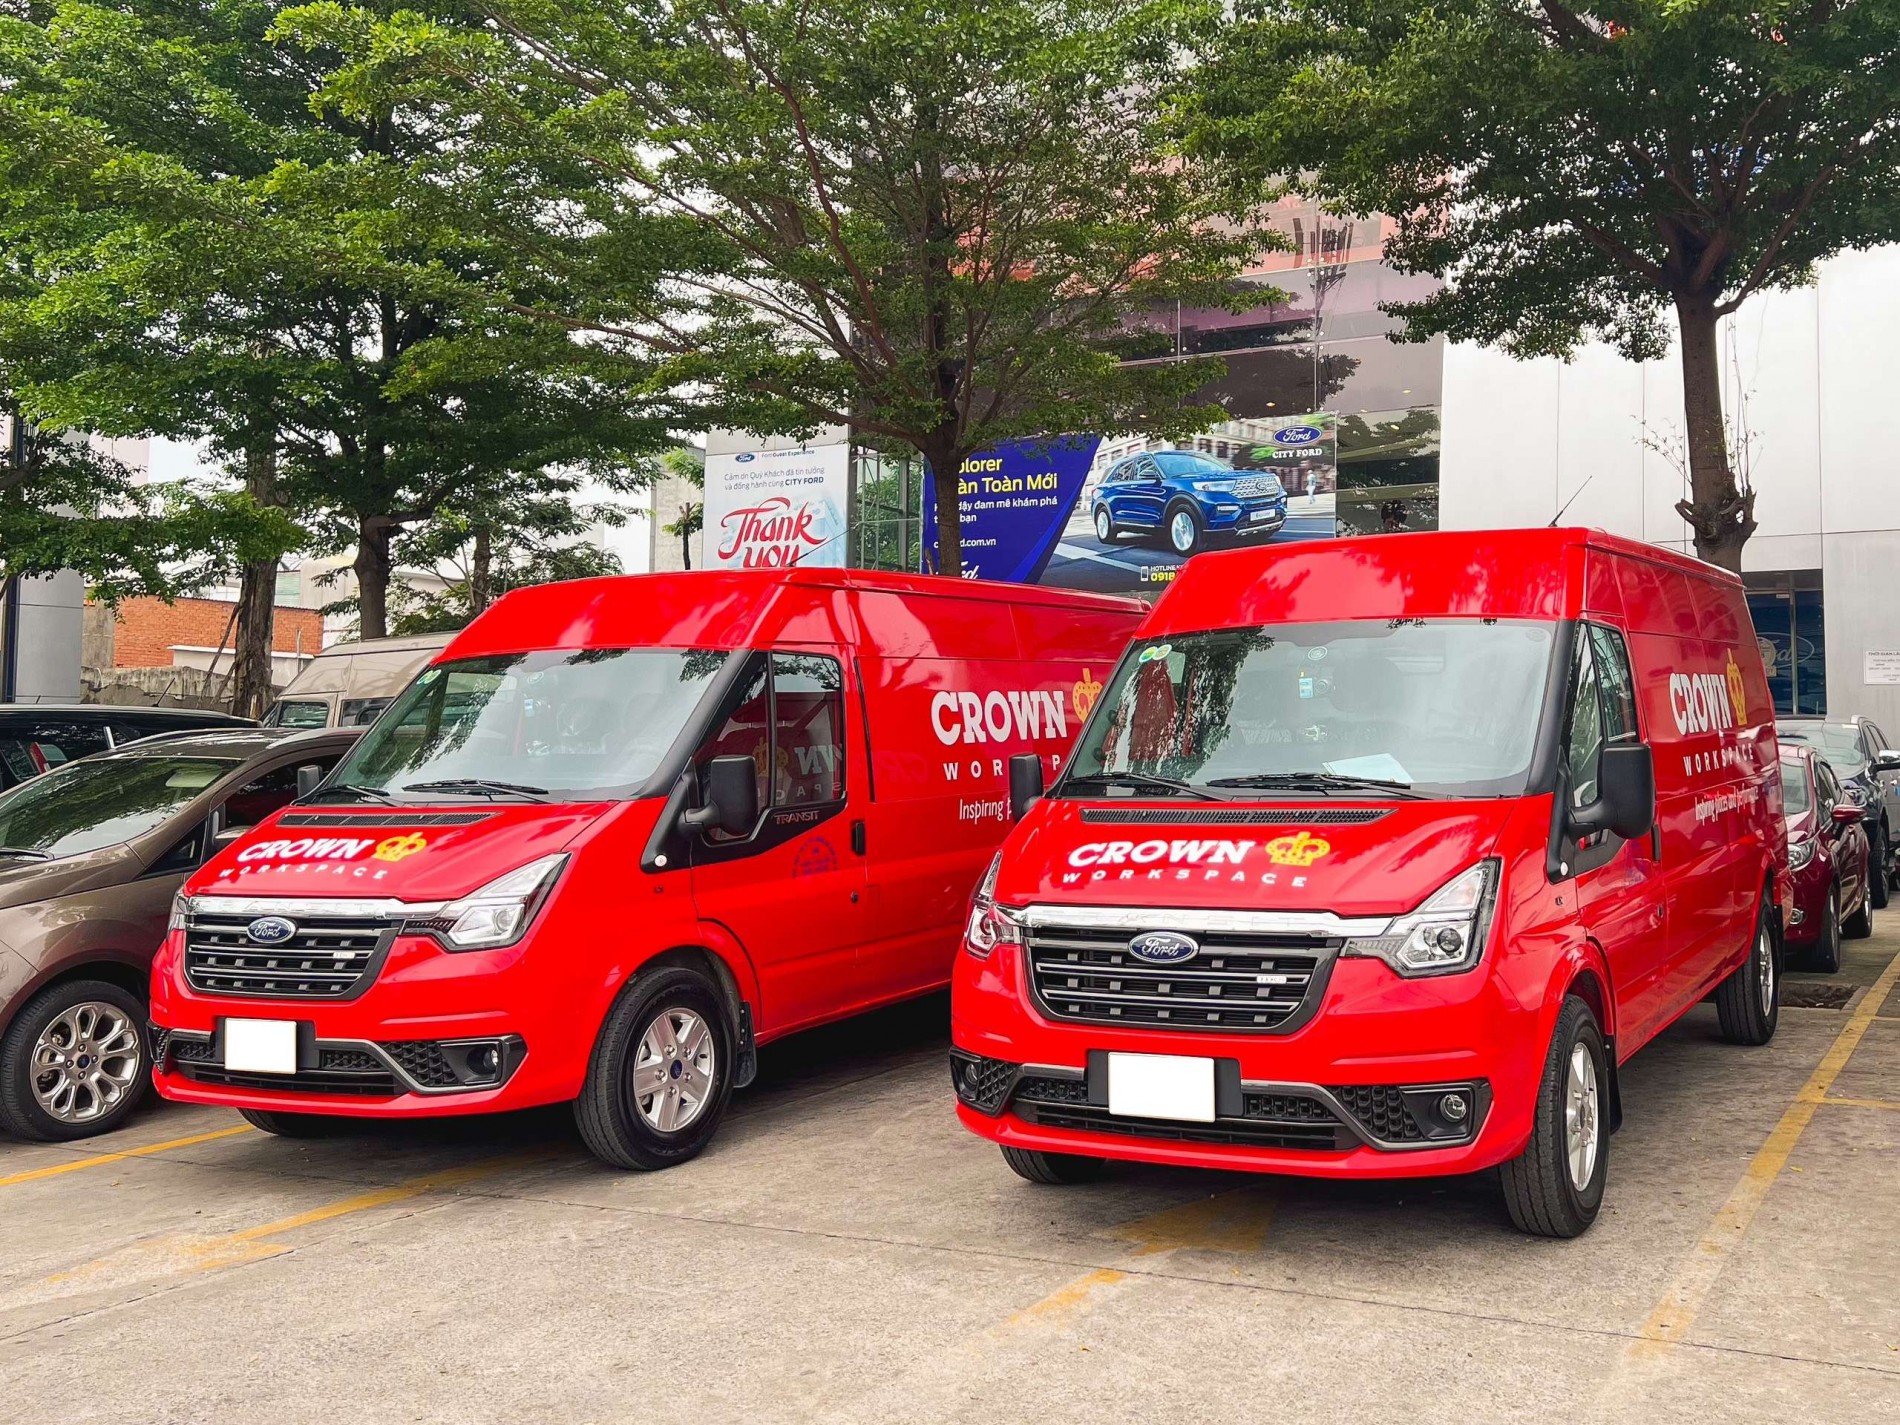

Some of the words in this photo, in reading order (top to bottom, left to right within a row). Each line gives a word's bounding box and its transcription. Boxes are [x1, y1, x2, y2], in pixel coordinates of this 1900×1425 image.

[1283, 428, 1311, 441] Ford
[1272, 450, 1295, 459] CITY
[1296, 448, 1323, 458] FORD
[795, 467, 804, 475] tin
[959, 458, 1003, 474] lorer
[784, 477, 803, 486] CITY
[803, 476, 824, 485] FORD
[958, 478, 978, 495] àn
[981, 475, 1023, 493] Toàn
[1026, 473, 1058, 490] Mới
[974, 500, 994, 510] đam
[996, 498, 1011, 508] mê
[1012, 496, 1038, 507] khám
[1039, 495, 1058, 508] phá
[718, 496, 828, 560] Thank
[1669, 672, 1733, 736] CROWN
[931, 690, 1068, 746] CROWN
[1683, 743, 1754, 777] WORKSPACE
[774, 811, 819, 824] TRANSIT
[959, 797, 1004, 825] Inspiring
[1694, 797, 1715, 826] Inspiring
[238, 838, 376, 862] CROWN
[1068, 840, 1256, 867] CROWN
[219, 864, 388, 880] WORKSPACE
[1062, 869, 1307, 887] WORKSPACE
[255, 918, 281, 938] Ford
[1142, 938, 1179, 957] Ford
